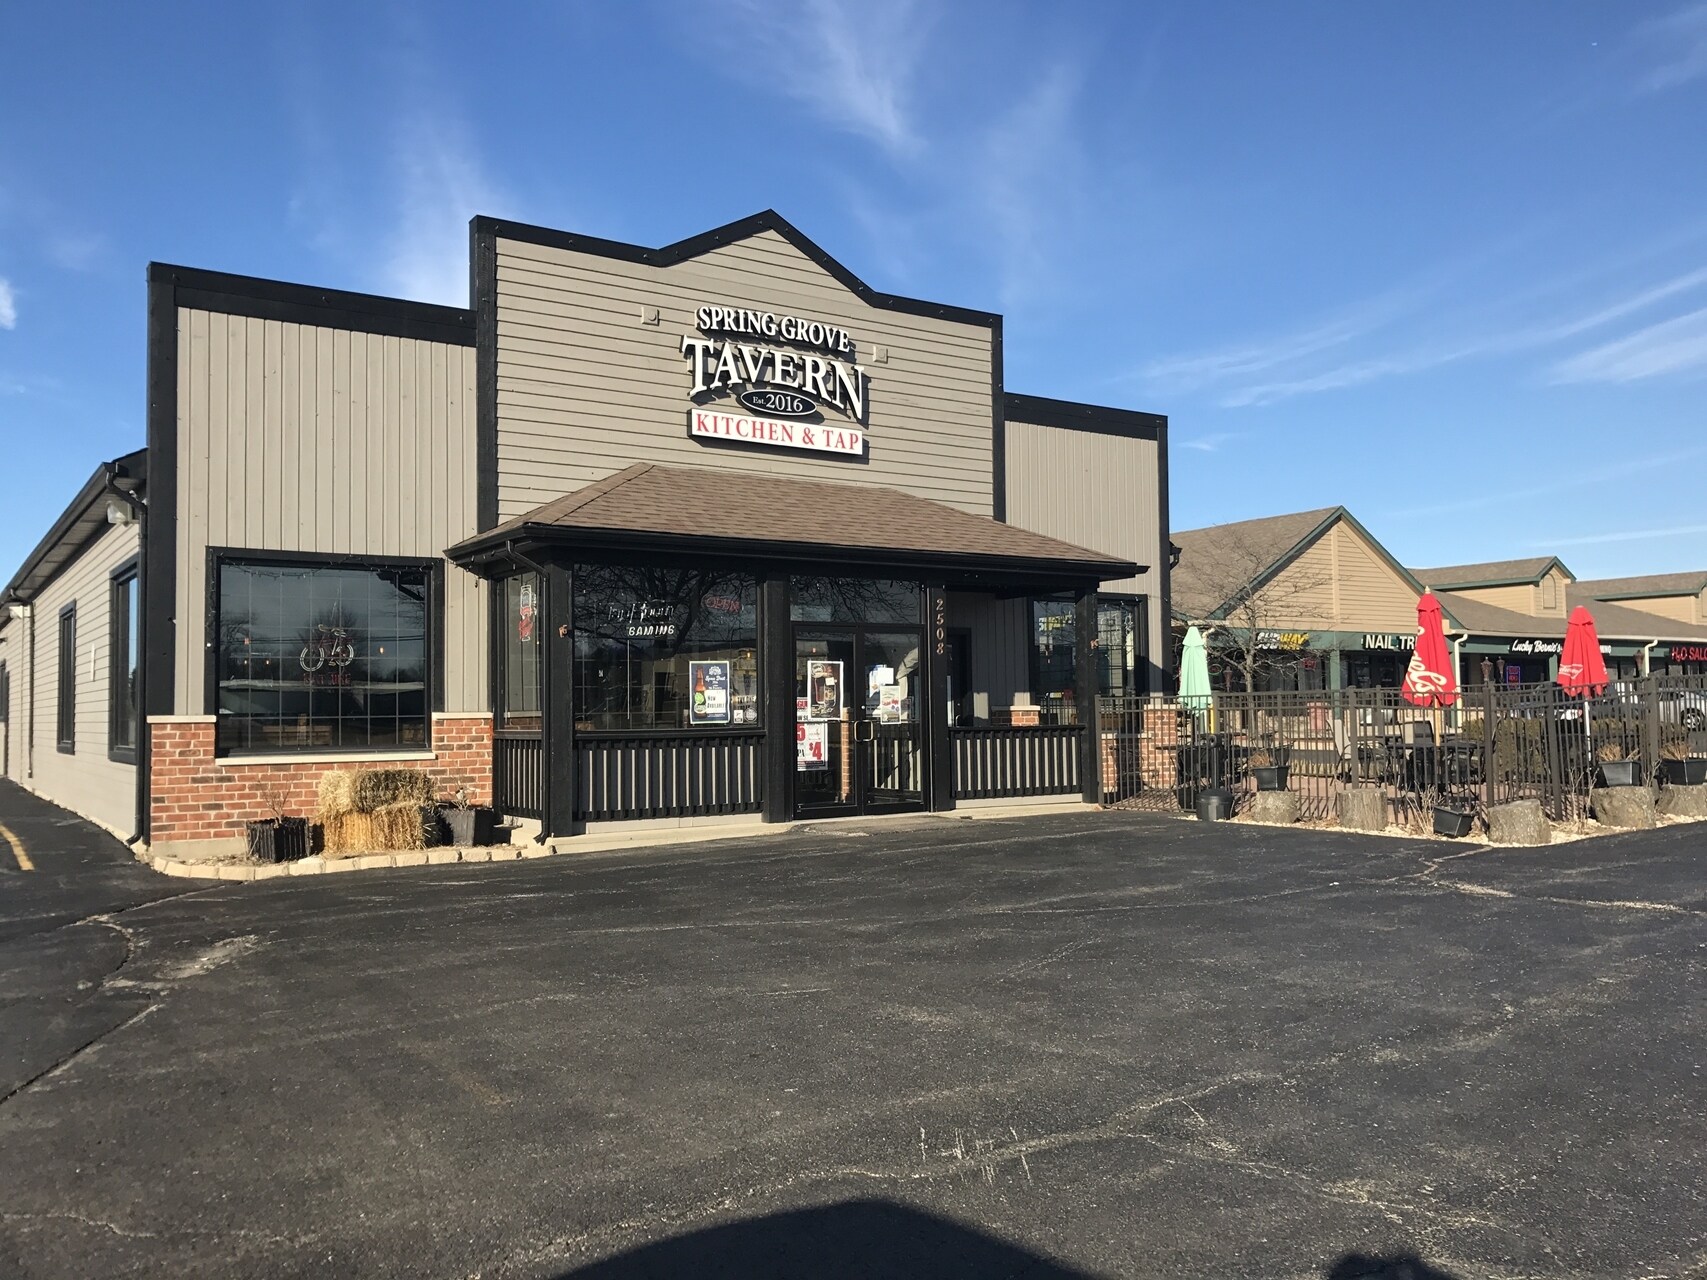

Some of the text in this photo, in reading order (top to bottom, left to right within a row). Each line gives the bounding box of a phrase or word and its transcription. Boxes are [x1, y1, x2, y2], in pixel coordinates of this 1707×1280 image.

[699, 306, 850, 353] SPRING GROVE
[681, 334, 865, 420] TAVERN
[766, 393, 803, 412] 2016
[696, 413, 859, 450] KITCHEN & TAP
[628, 624, 675, 637] GAMING
[936, 598, 944, 655] 2508
[1365, 634, 1417, 650] NAIL TR
[1512, 639, 1534, 655] Lucky
[1534, 640, 1561, 653] Bernie's
[809, 741, 823, 761] $4
